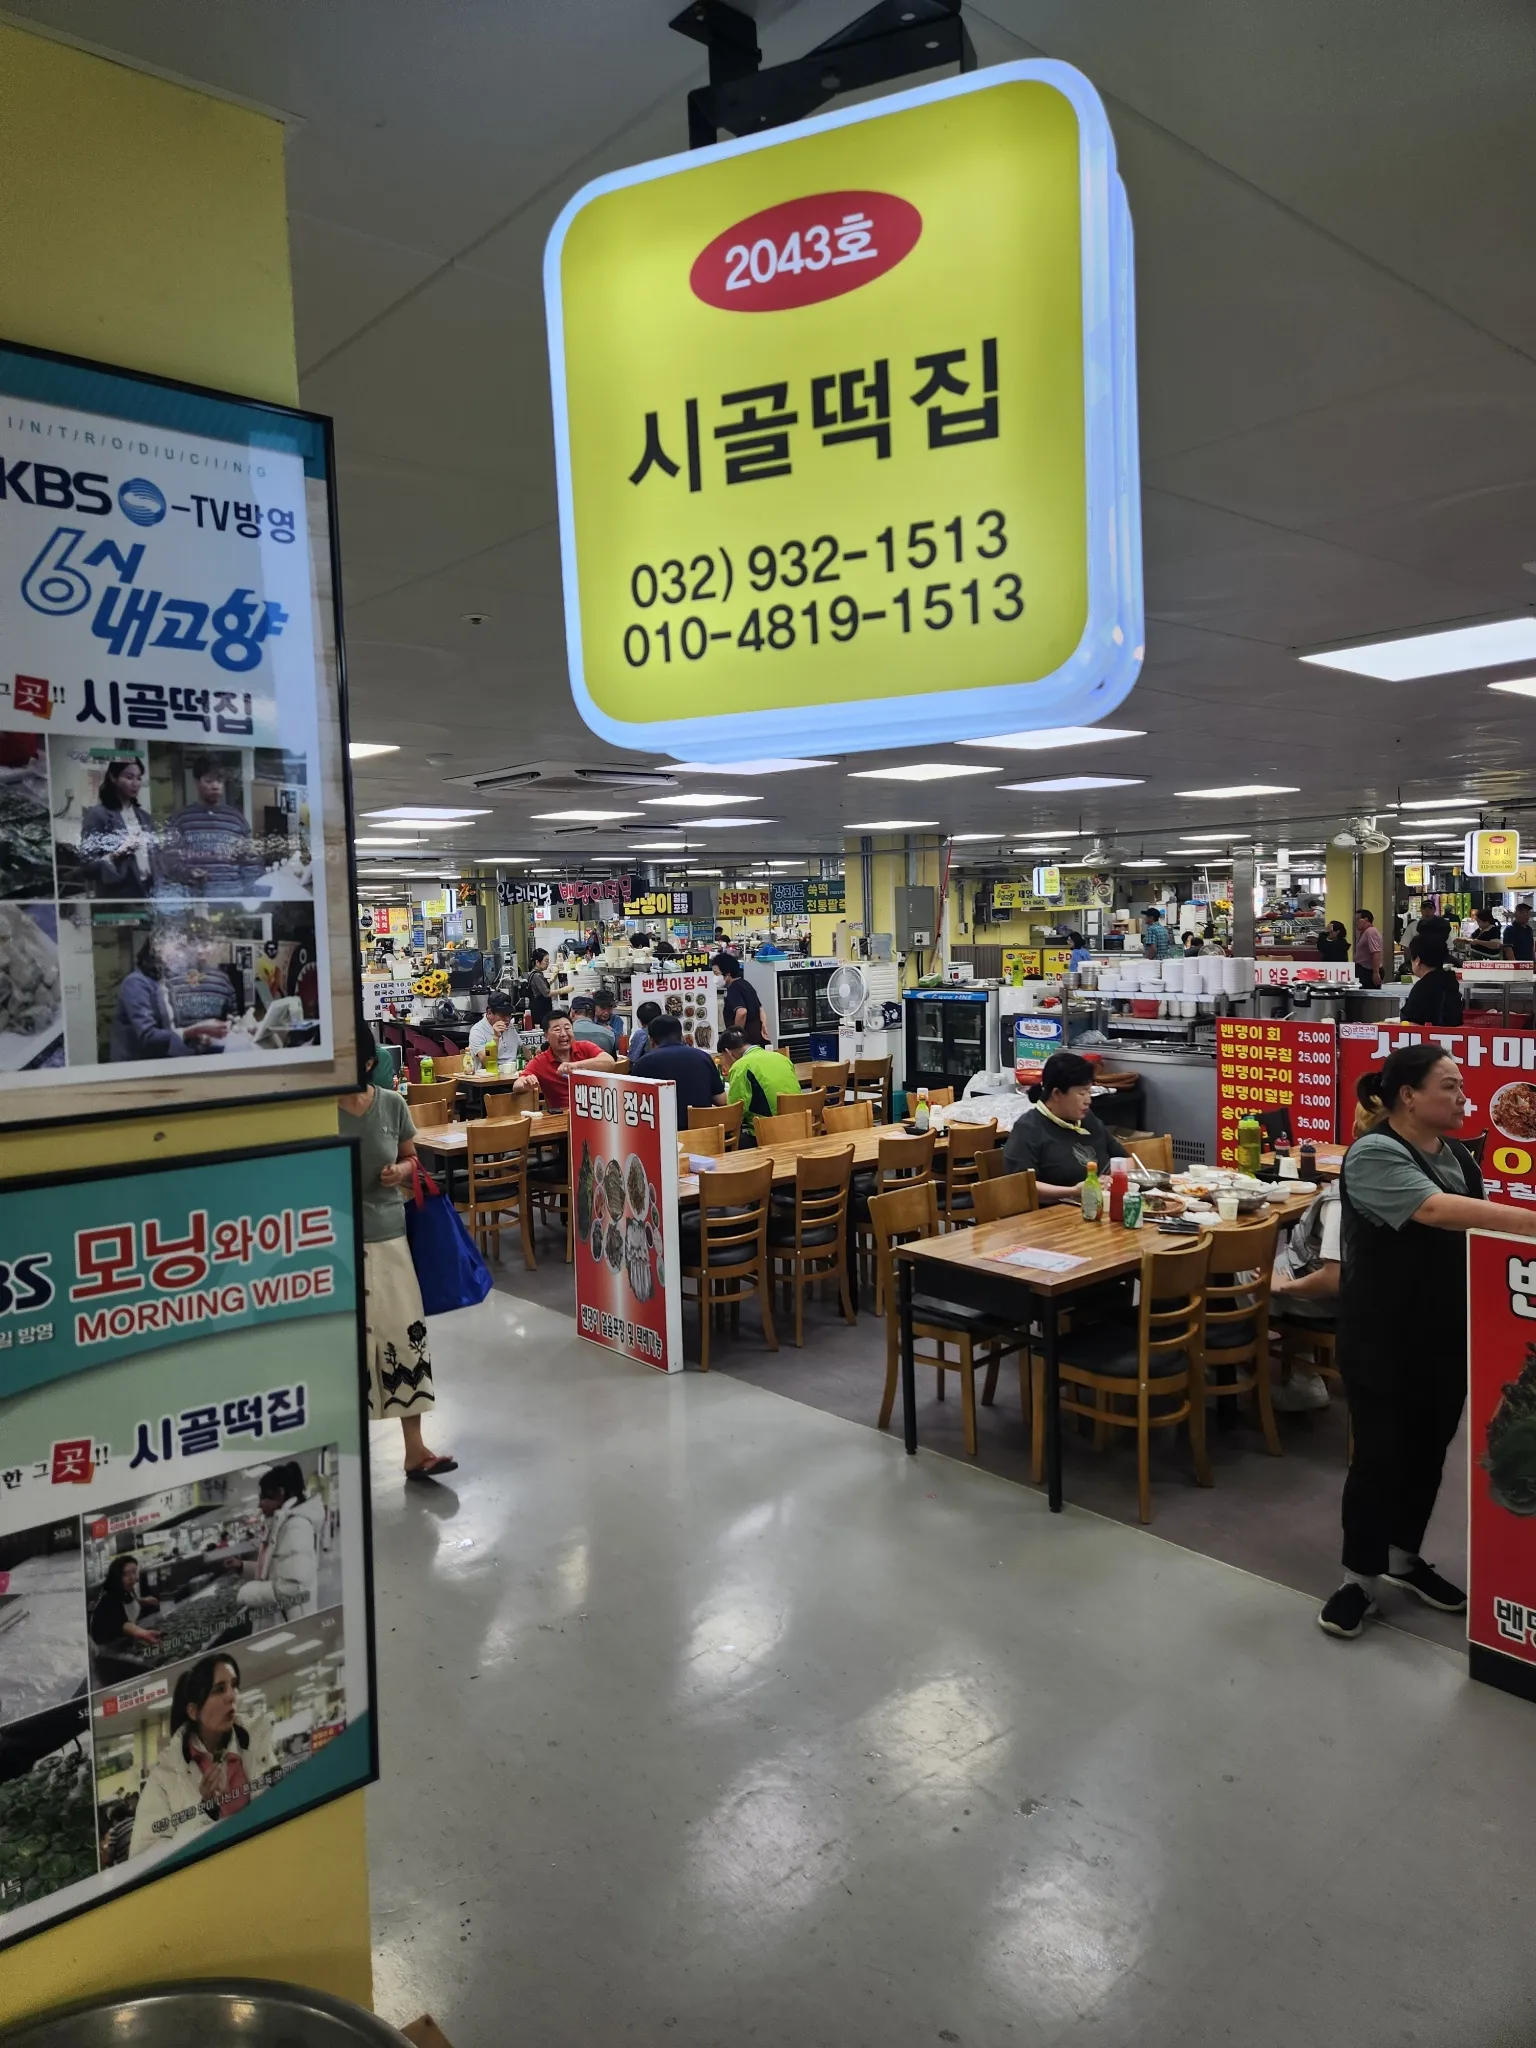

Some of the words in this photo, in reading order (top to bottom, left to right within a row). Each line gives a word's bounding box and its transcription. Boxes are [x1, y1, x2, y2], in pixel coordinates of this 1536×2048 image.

[725, 211, 878, 291] 2043호
[629, 337, 1000, 493] 시골떡집
[0, 457, 112, 515] KBS
[631, 546, 735, 609] 032)
[748, 509, 1007, 592] 932-1513
[92, 586, 289, 672] 내고향
[623, 573, 1025, 669] 010-4819-1513
[76, 679, 254, 735] 시골떡집
[719, 893, 757, 905] 수부꾸미
[773, 884, 805, 899] 강화도
[773, 899, 805, 914] 강화도
[1221, 1024, 1263, 1041] 밴댕이
[1267, 1027, 1281, 1041] 회
[1221, 1044, 1292, 1063] 밴댕이무침
[1221, 1064, 1292, 1084] 밴댕이구이
[1221, 1084, 1294, 1105] 밴댕이덮밥
[574, 1083, 618, 1124] 밴댕이
[623, 1090, 655, 1130] 정식
[70, 1205, 335, 1302] 모닝와이드
[18, 1322, 53, 1345] 방영
[76, 1286, 245, 1346] MORNING
[252, 1266, 334, 1309] WIDE
[580, 1304, 600, 1334] 밴댕이
[626, 1326, 635, 1349] 및
[636, 1328, 662, 1361] 택배가능
[129, 1384, 308, 1470] 시골떡집
